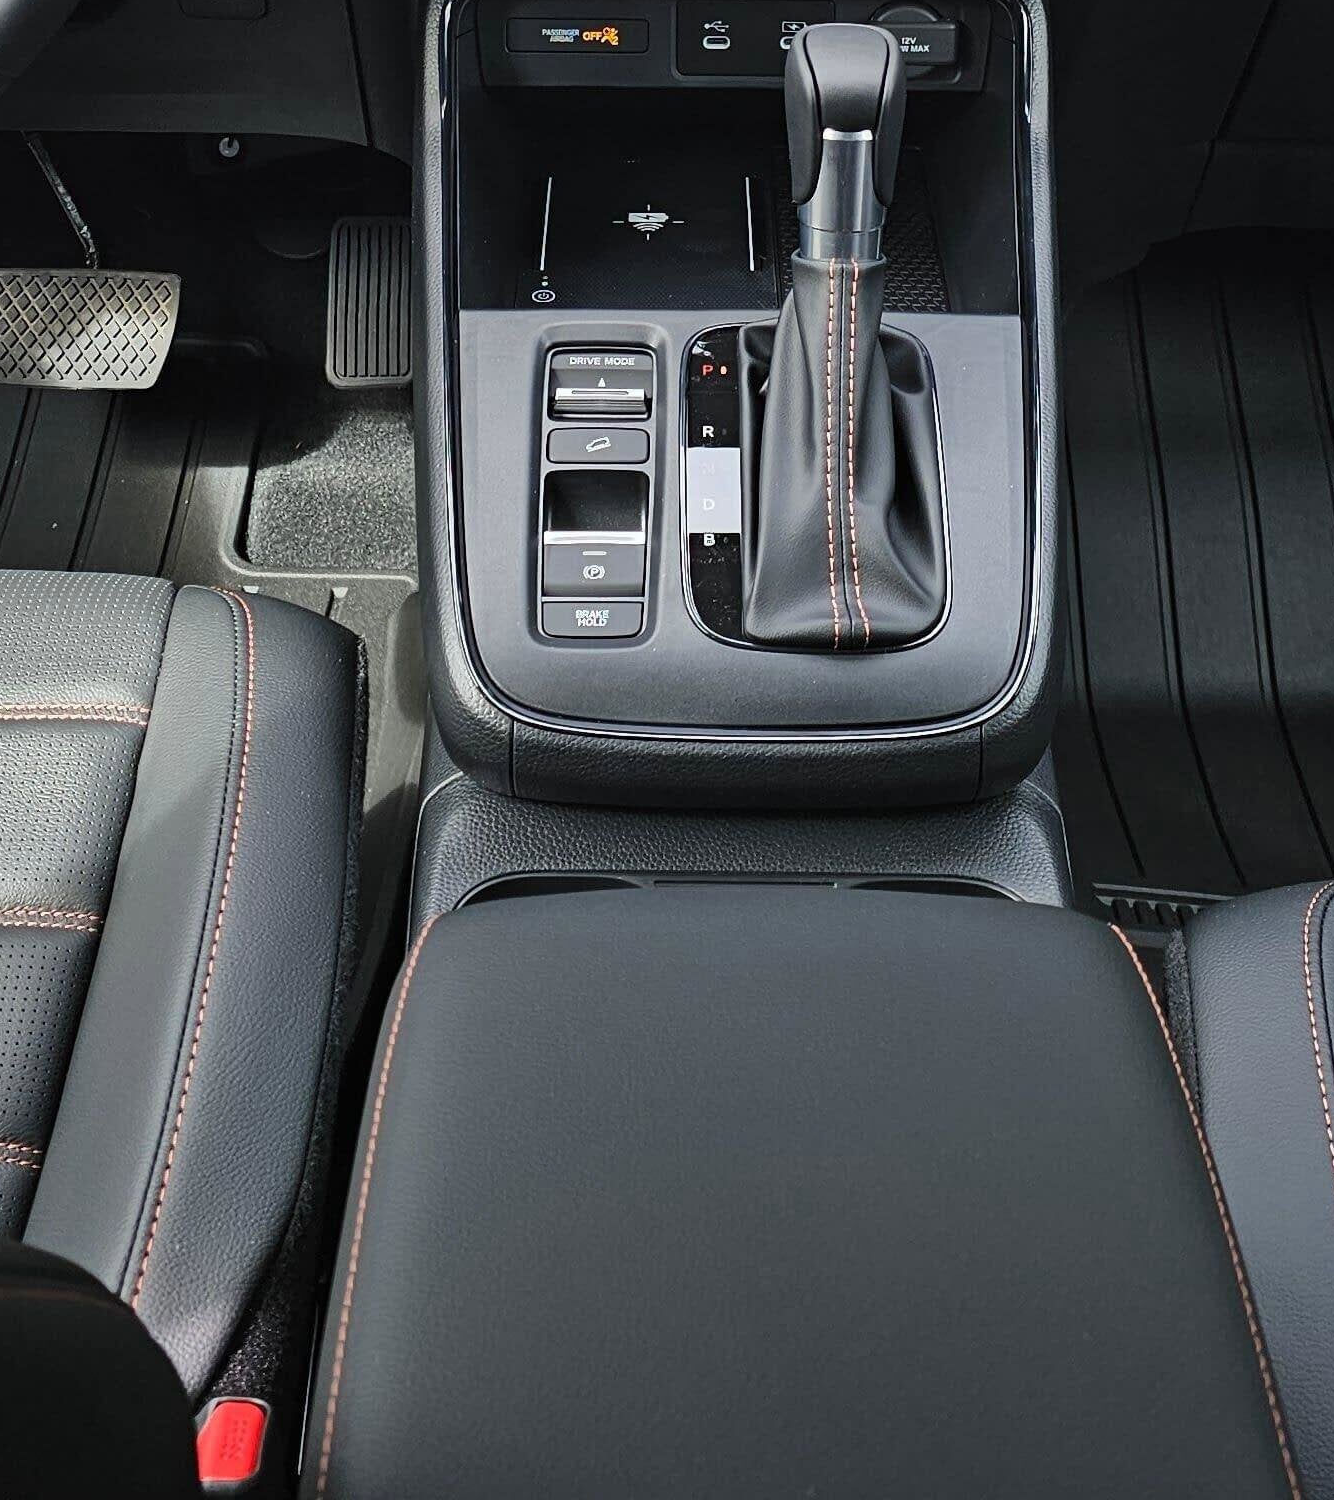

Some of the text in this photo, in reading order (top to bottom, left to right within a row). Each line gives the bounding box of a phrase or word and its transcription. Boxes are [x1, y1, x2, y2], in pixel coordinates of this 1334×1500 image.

[582, 31, 603, 42] OFF
[900, 36, 917, 45] 12V
[910, 44, 930, 53] MAX
[569, 356, 636, 366] DRIVE MODE
[702, 364, 714, 376] P
[702, 425, 715, 438] R
[702, 498, 716, 511] D
[702, 532, 716, 547] B
[575, 609, 610, 619] BRAKE
[577, 617, 608, 628] HOLD
